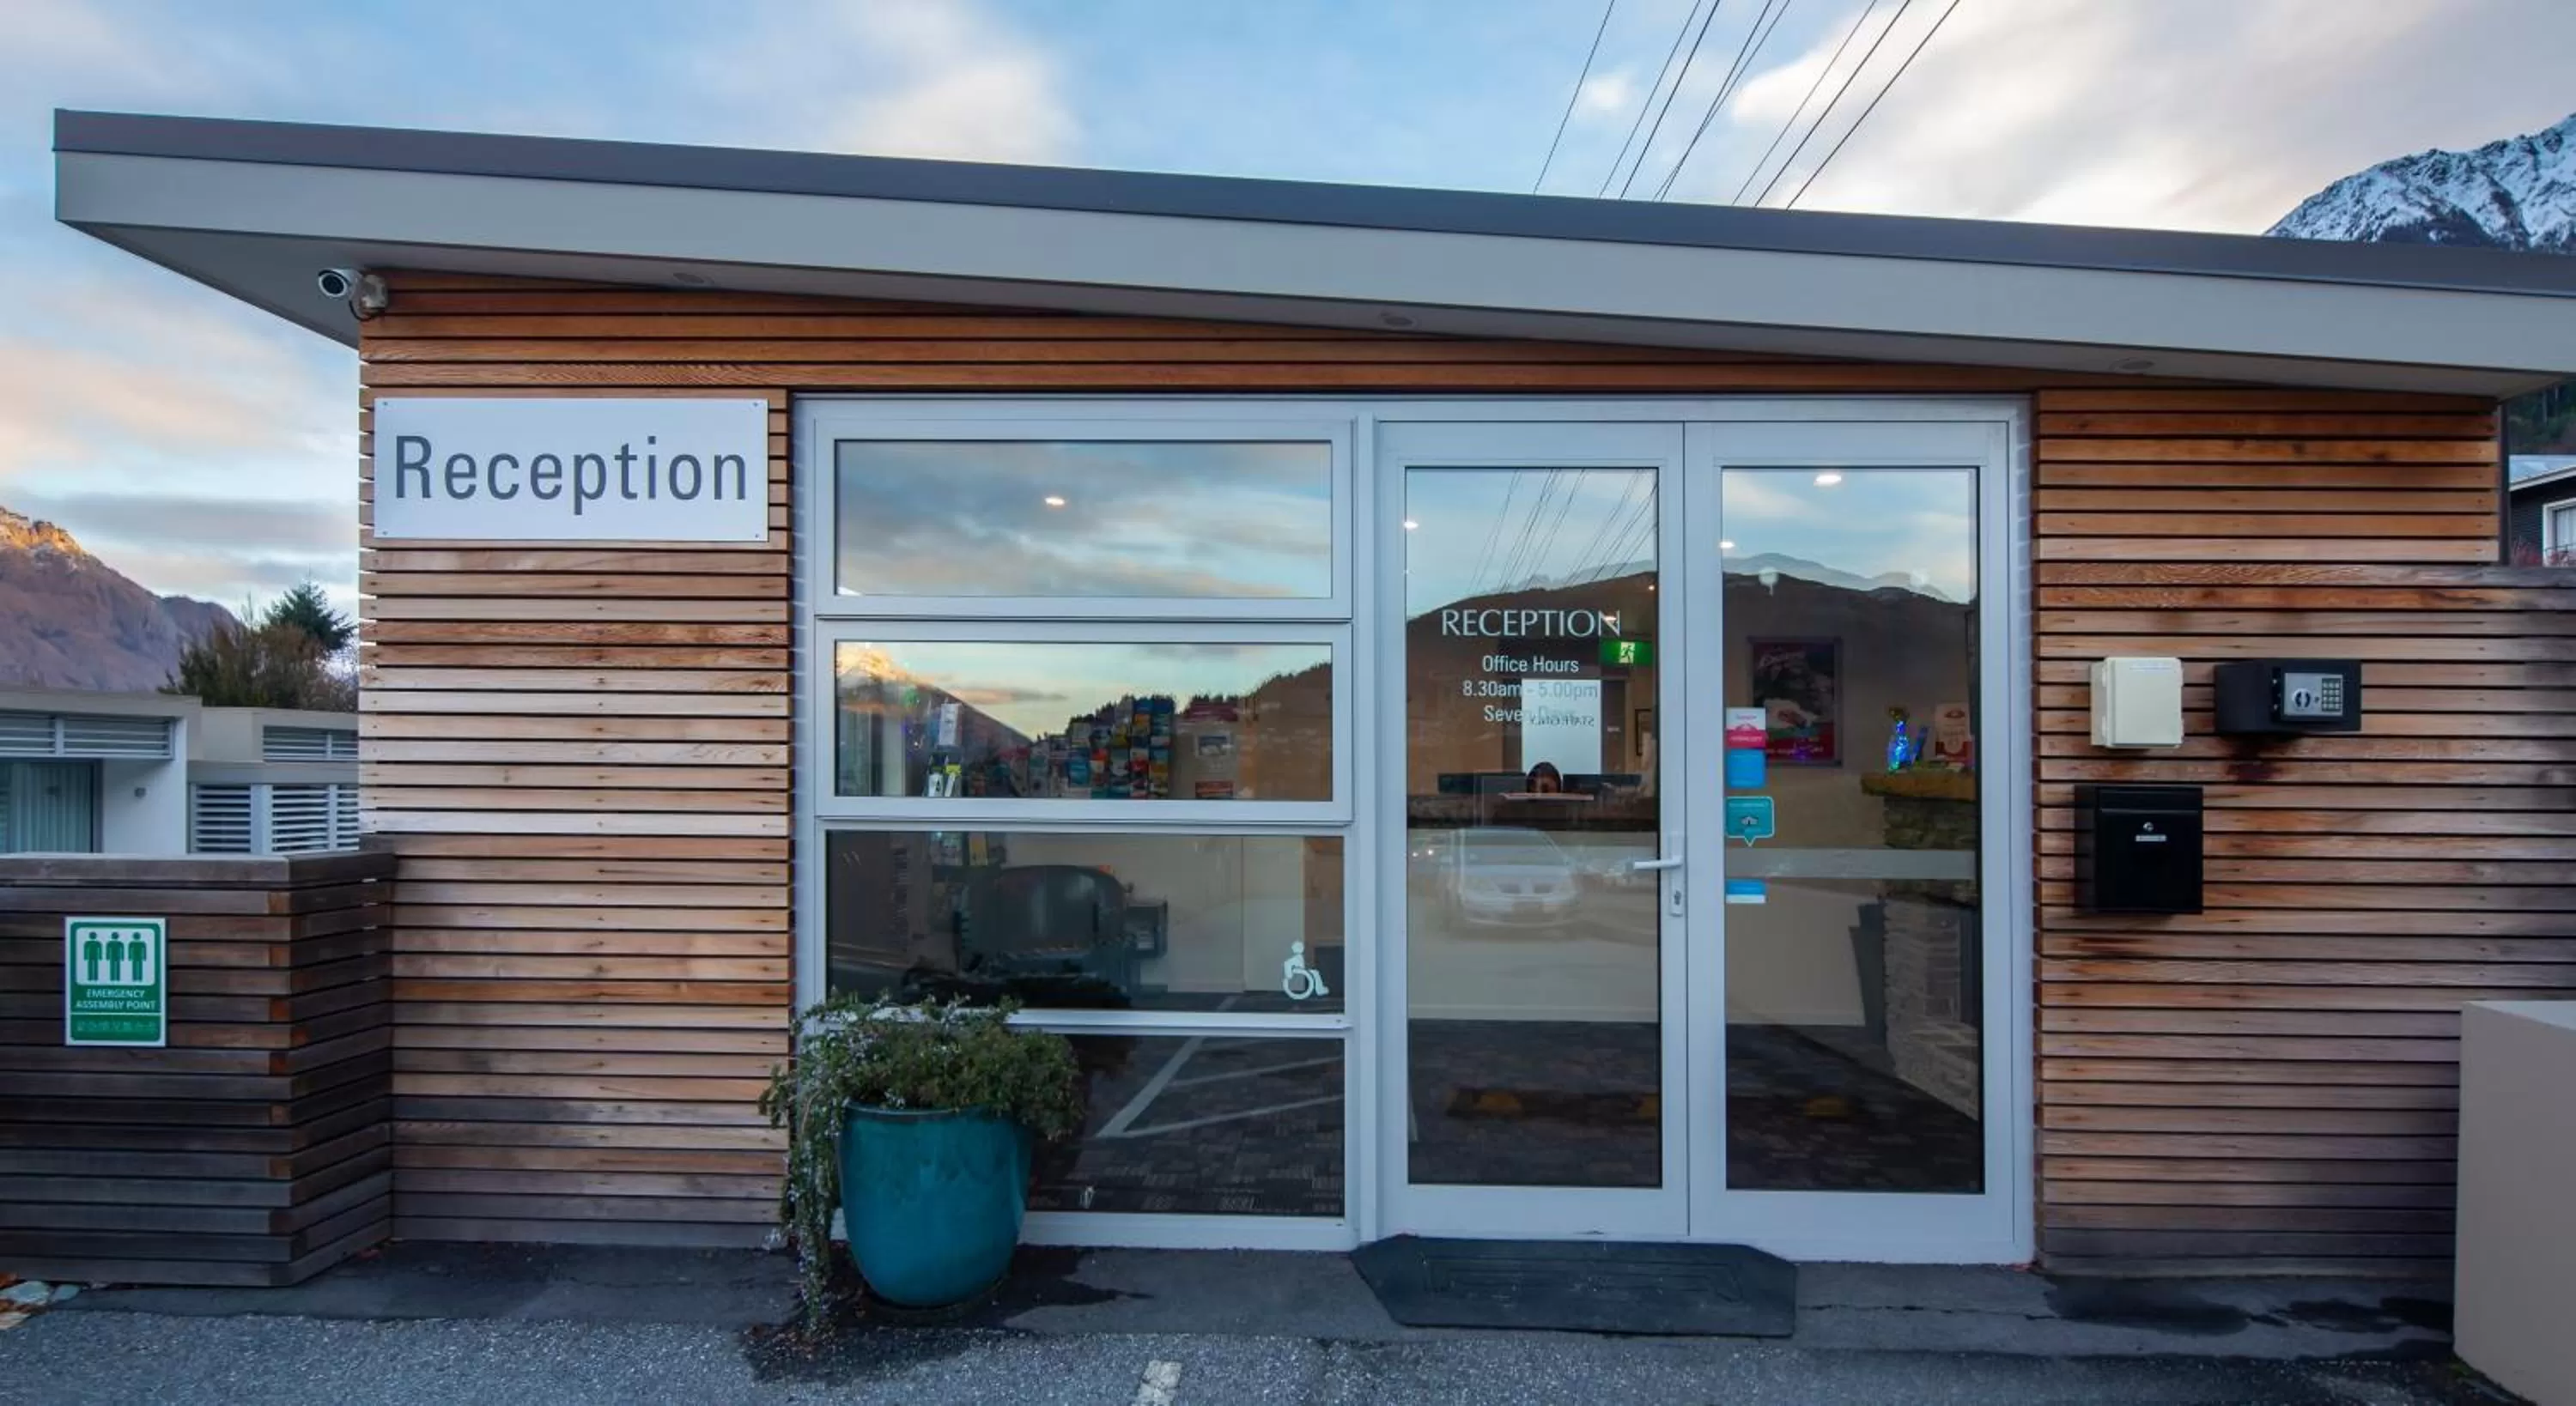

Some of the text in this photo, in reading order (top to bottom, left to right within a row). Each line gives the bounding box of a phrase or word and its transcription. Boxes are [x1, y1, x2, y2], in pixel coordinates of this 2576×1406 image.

[396, 435, 746, 515] Reception
[1441, 609, 1621, 638] RECEPTION
[1482, 655, 1579, 673] Office Hours
[1462, 680, 1522, 698] 8.30am
[1538, 681, 1598, 701] 5.00pm
[86, 988, 145, 998] EMERGENCY
[76, 1000, 156, 1009] ASSEMBLY POINT
